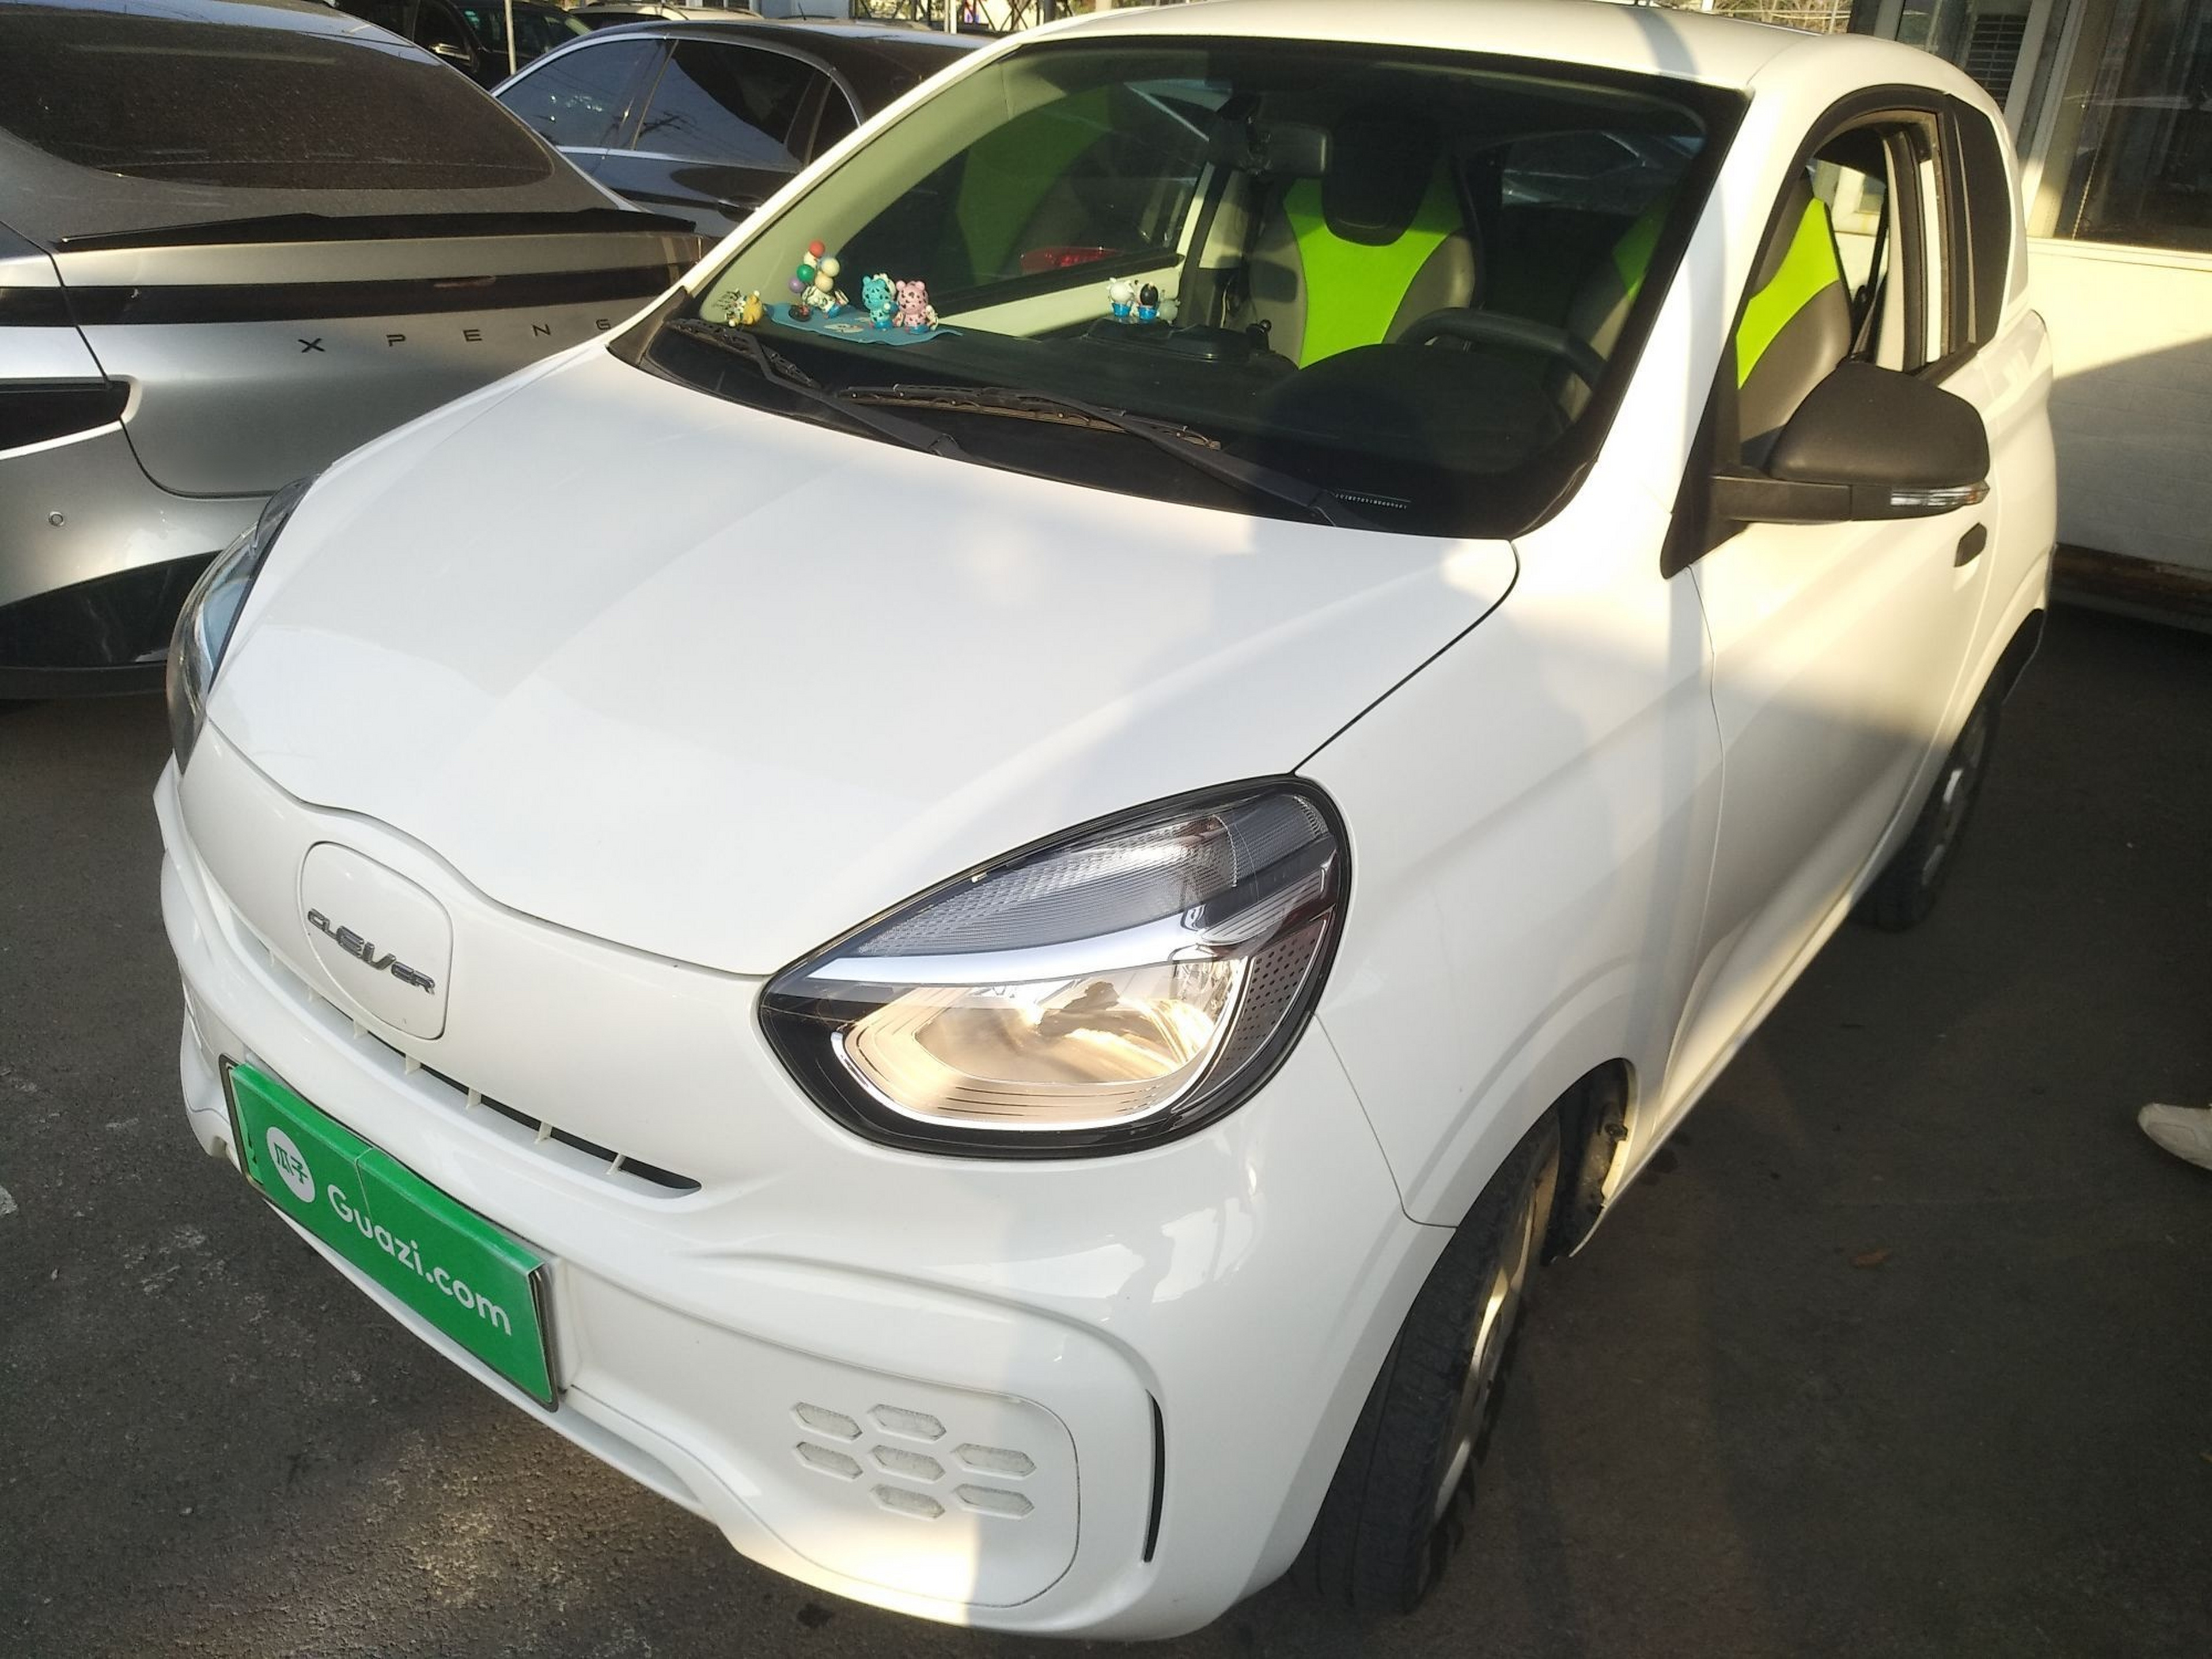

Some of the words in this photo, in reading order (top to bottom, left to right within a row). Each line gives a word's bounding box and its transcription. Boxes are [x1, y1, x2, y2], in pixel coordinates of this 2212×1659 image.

[308, 908, 435, 995] CLEVER
[273, 1142, 309, 1184] 瓜子
[327, 1184, 512, 1336] Guazi.com
